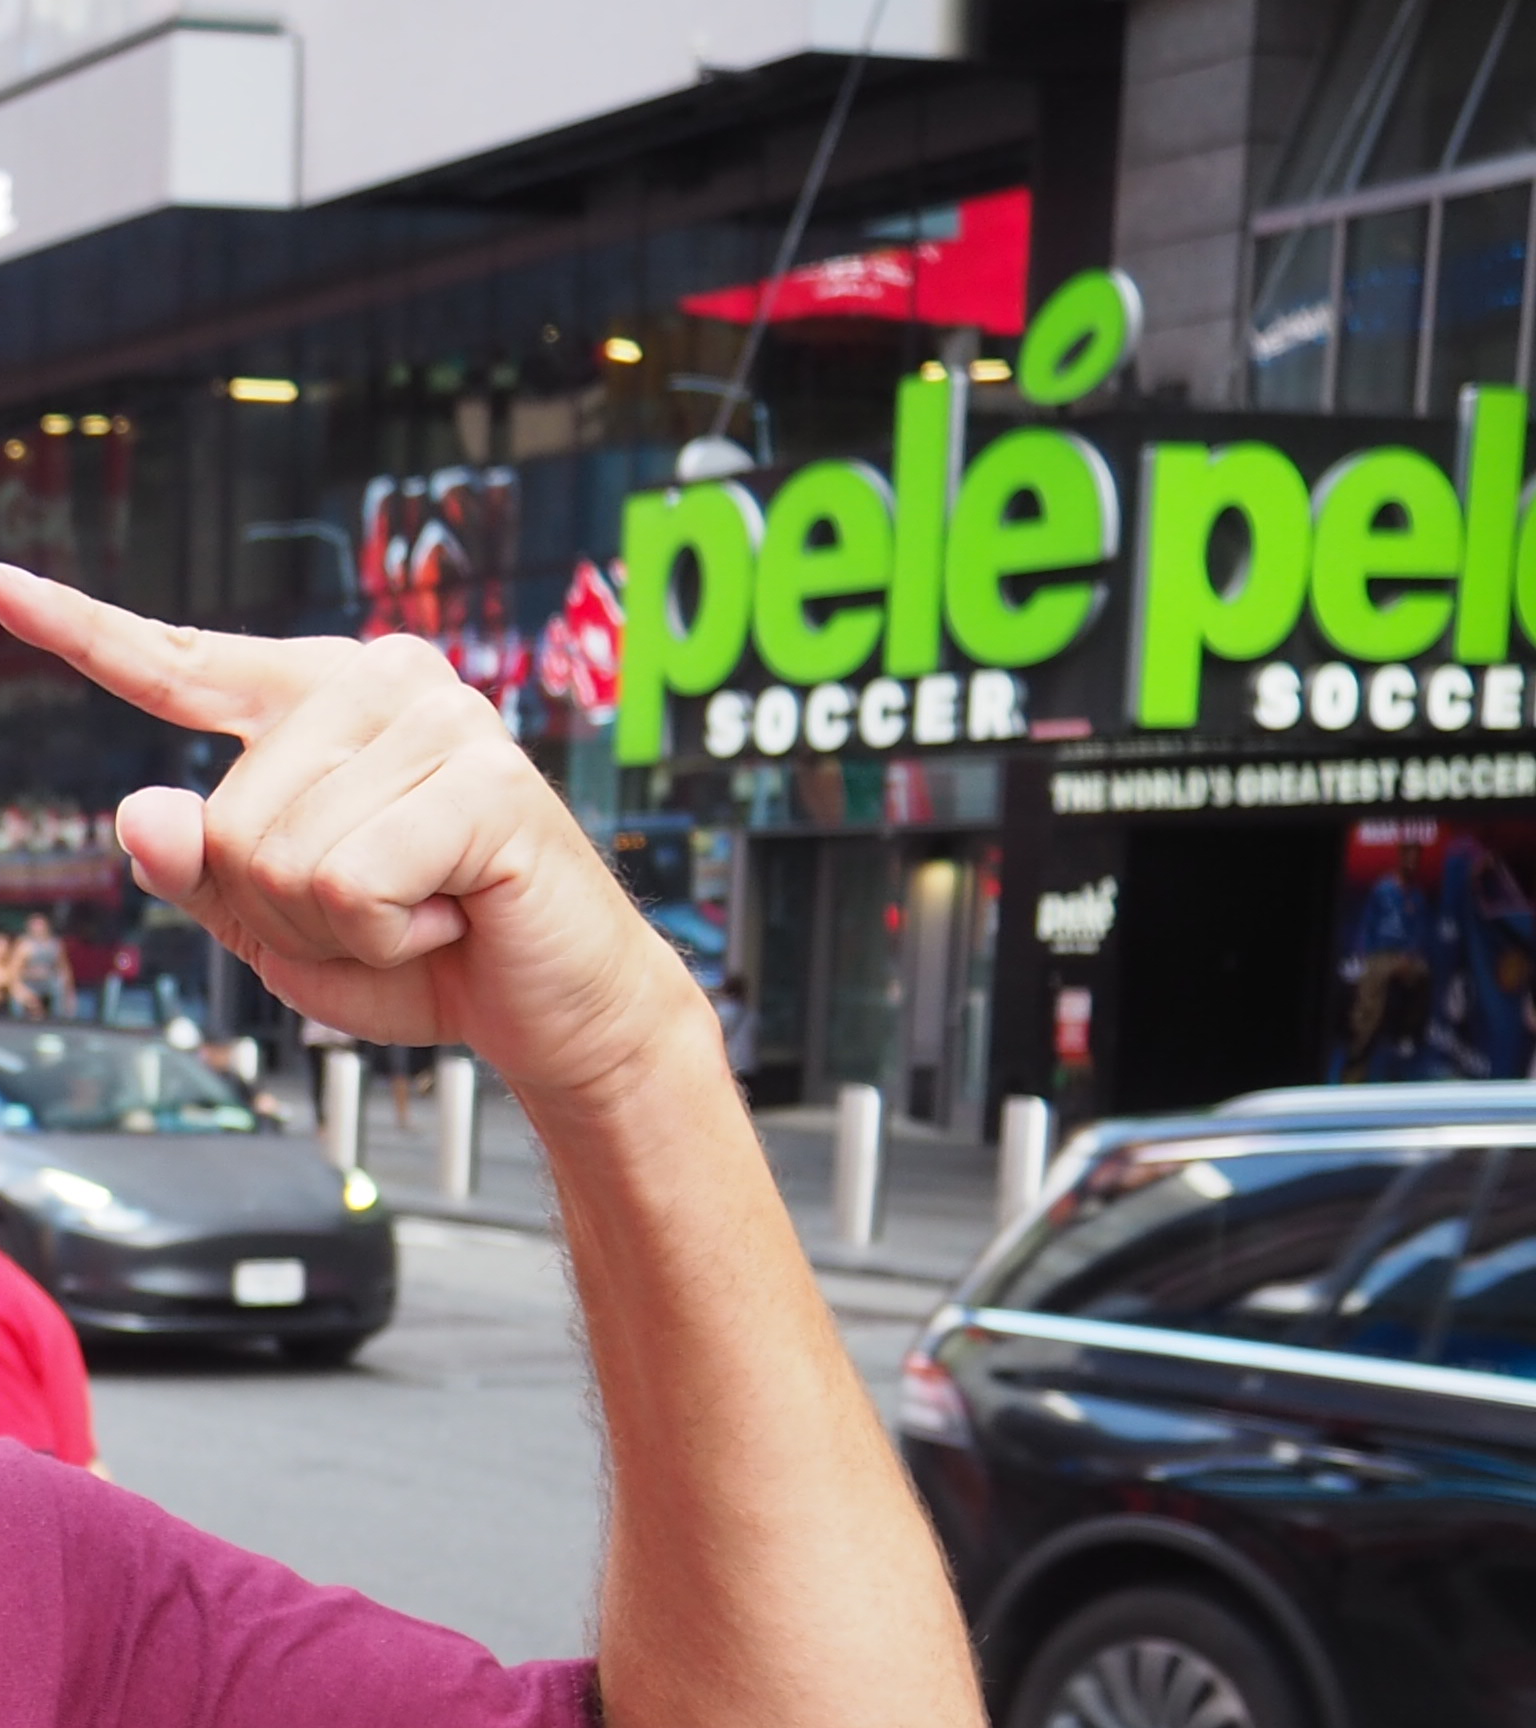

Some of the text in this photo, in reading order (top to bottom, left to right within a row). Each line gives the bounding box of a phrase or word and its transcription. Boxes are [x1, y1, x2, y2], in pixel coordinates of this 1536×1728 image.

[614, 268, 1143, 766] pelé
[1128, 382, 1536, 728] pel
[705, 666, 1025, 758] SOCCER
[1254, 662, 1536, 731] SOCCE
[1052, 770, 1106, 814] THE
[1109, 767, 1232, 809] WORLD'S
[1235, 758, 1401, 806] GREATEST
